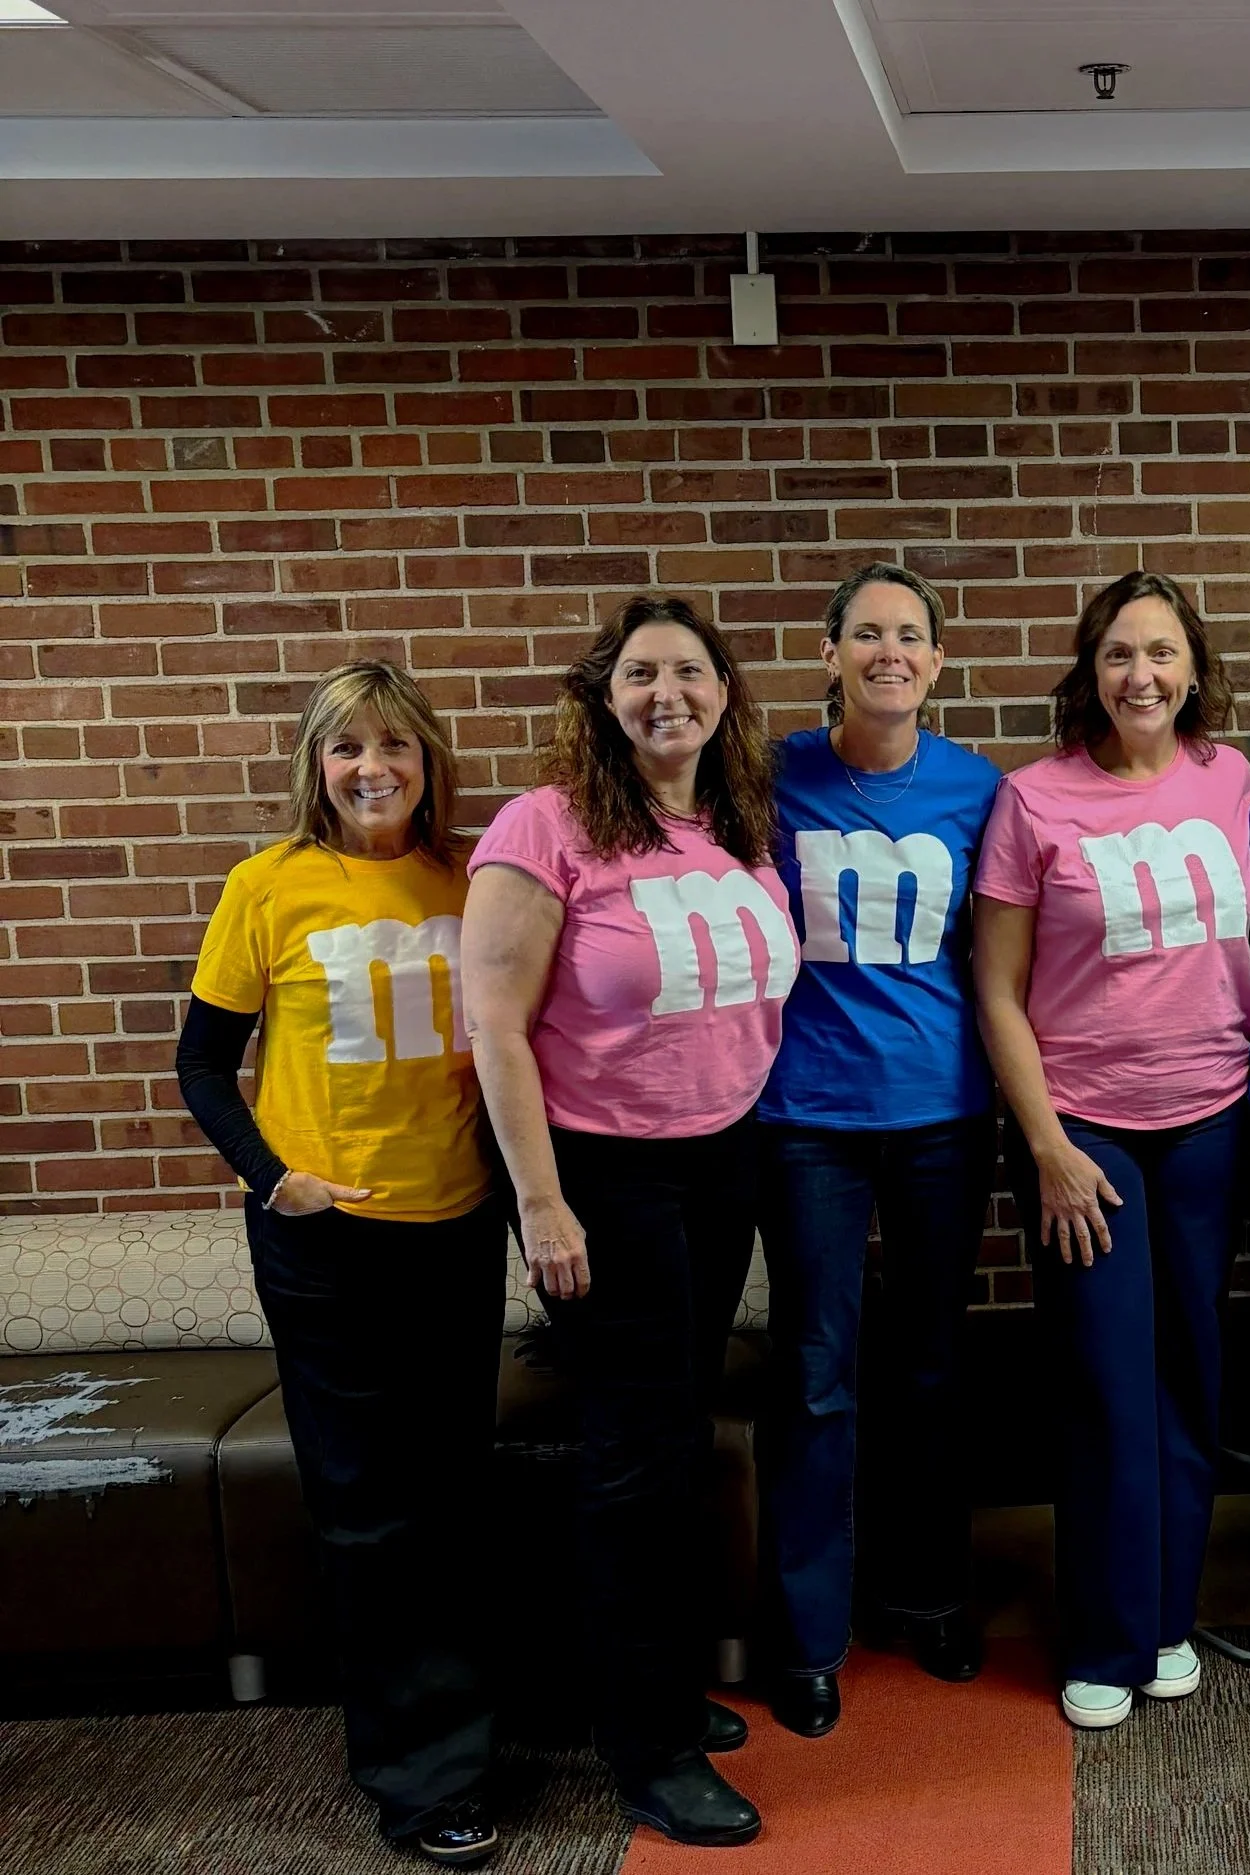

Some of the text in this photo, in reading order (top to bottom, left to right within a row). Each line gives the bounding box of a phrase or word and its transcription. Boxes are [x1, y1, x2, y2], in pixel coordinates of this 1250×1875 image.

[629, 870, 800, 1016] m
[795, 830, 953, 965] m
[1078, 818, 1247, 957] m
[307, 914, 472, 1064] m
